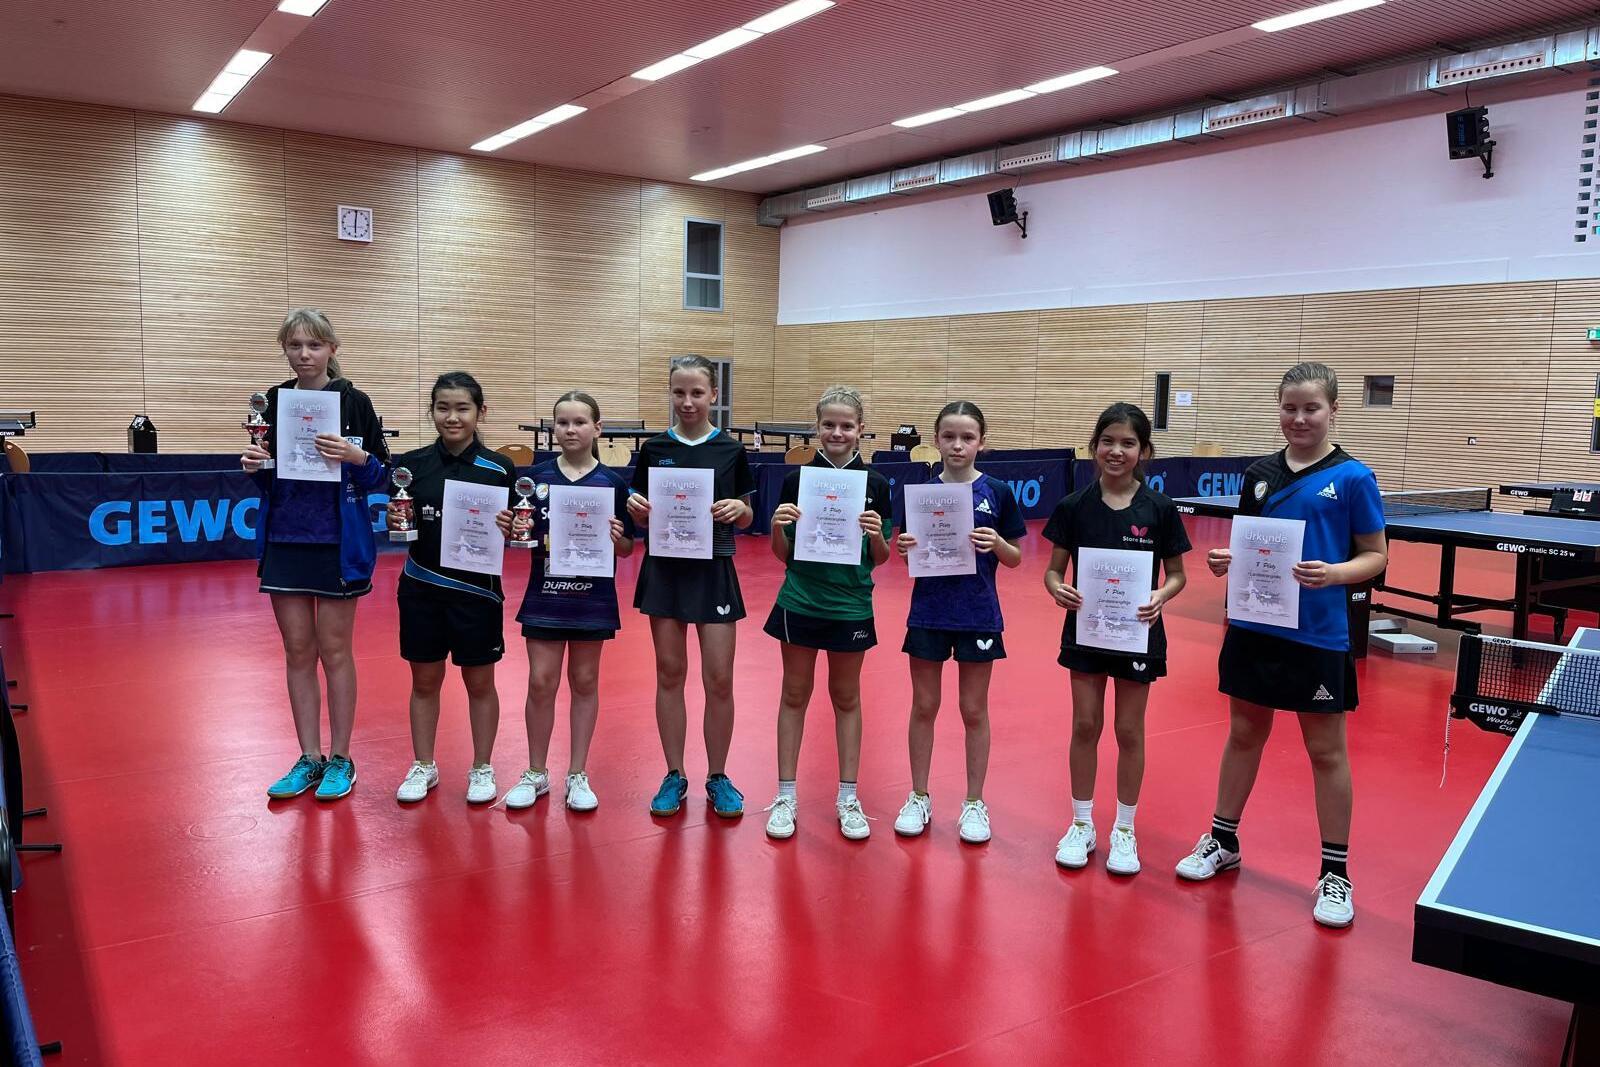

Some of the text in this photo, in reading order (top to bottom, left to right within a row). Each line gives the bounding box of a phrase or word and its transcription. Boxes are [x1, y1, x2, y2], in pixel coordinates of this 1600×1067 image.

[1197, 472, 1245, 497] GEW
[1245, 531, 1288, 544] Urkunde
[1497, 543, 1526, 553] GEWO
[1093, 562, 1137, 574] Urkunde
[1351, 592, 1368, 600] GEWO
[1469, 703, 1508, 717] GEWO
[1486, 716, 1514, 725] World
